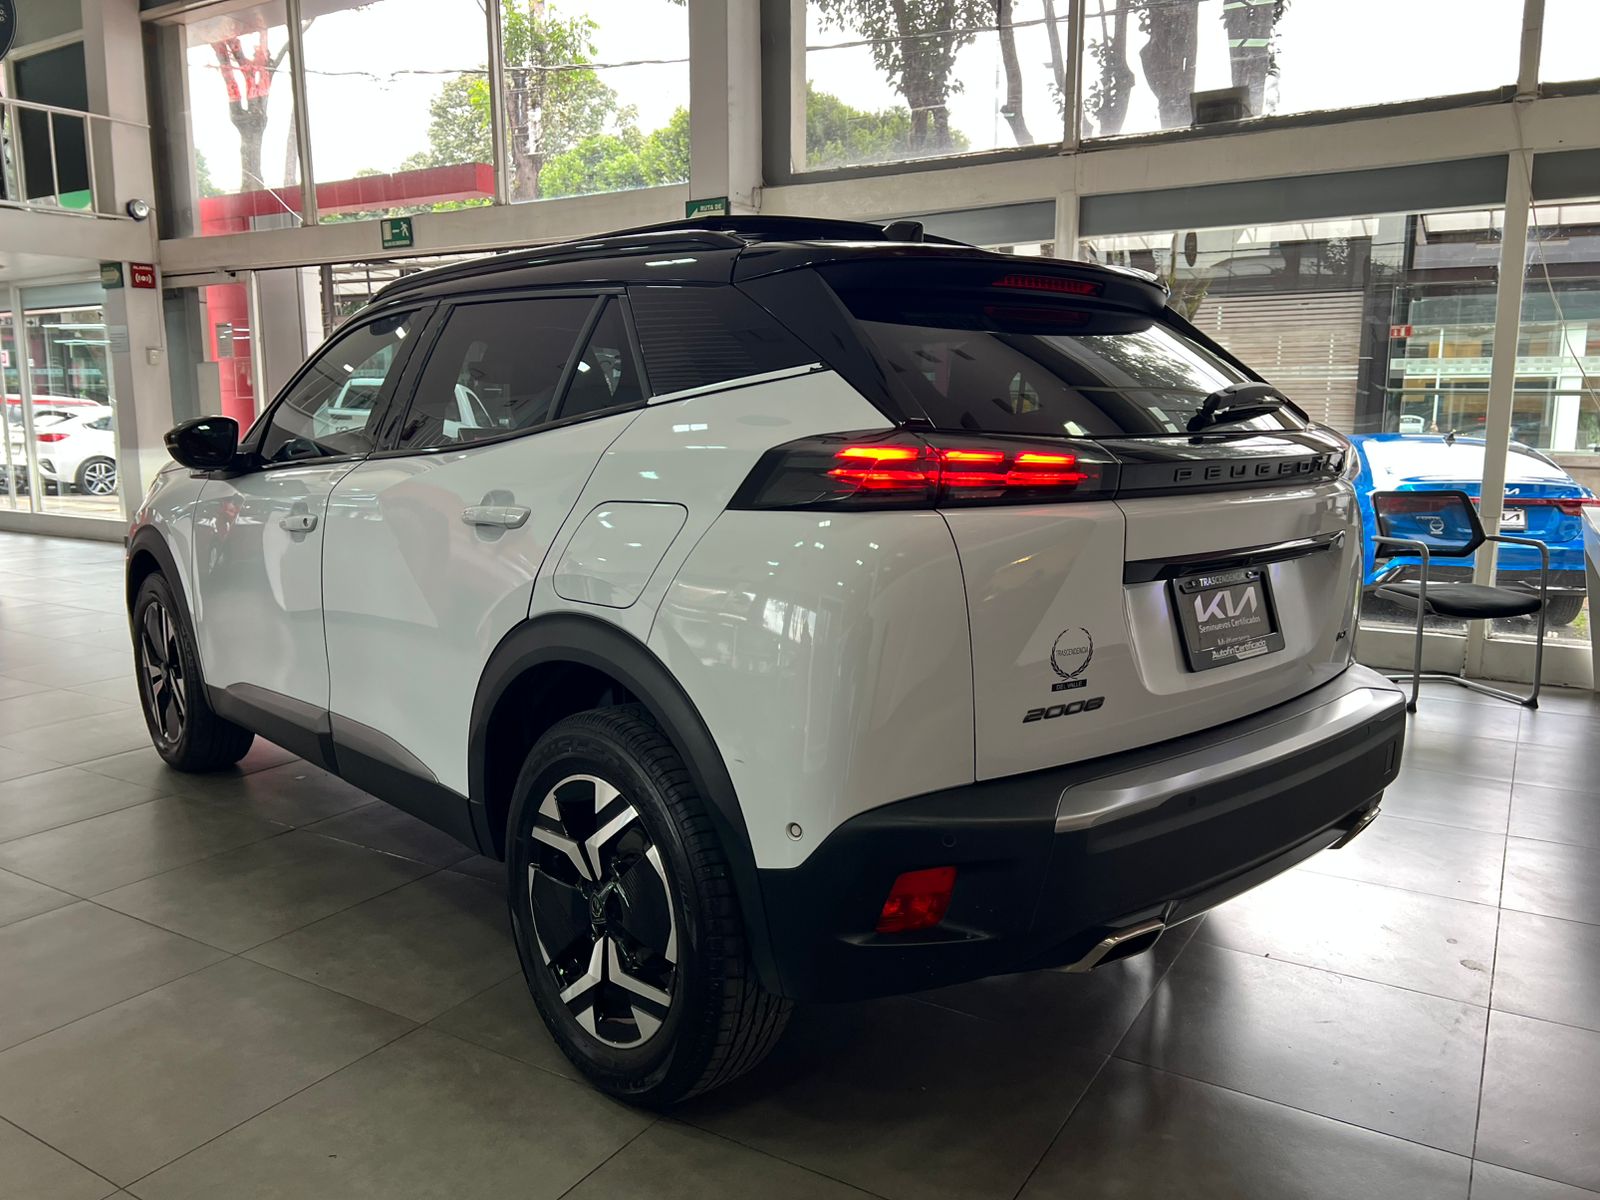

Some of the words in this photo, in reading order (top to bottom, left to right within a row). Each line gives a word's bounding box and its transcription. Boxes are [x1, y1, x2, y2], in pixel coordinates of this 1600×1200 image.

[1174, 458, 1327, 482] PEUGEOT
[1194, 586, 1258, 622] KIA
[1199, 621, 1231, 633] Seminuevos
[1231, 615, 1261, 628] Certificados
[1055, 646, 1089, 657] TRASCENDENCIA
[1022, 696, 1105, 723] 2008
